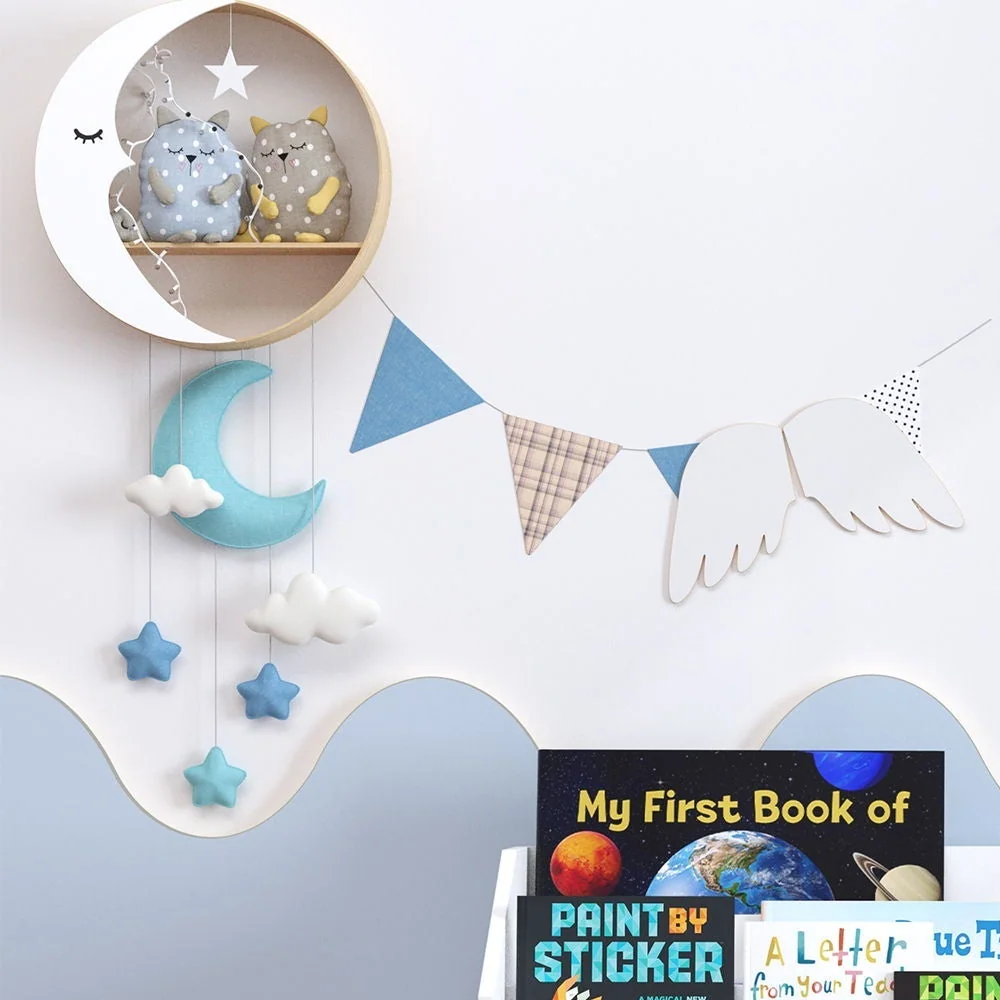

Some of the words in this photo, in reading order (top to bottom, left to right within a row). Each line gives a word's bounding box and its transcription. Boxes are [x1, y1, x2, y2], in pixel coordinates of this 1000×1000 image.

[577, 789, 631, 832] My
[644, 789, 741, 824] First
[754, 789, 854, 824] Book
[868, 791, 911, 824] of
[551, 902, 665, 937] PAINT
[668, 907, 708, 934] BY
[534, 941, 724, 983] STICKER
[765, 936, 785, 967] A
[796, 927, 907, 967] Letter
[933, 932, 971, 956] ue
[750, 971, 795, 1000] from
[797, 975, 842, 998] your
